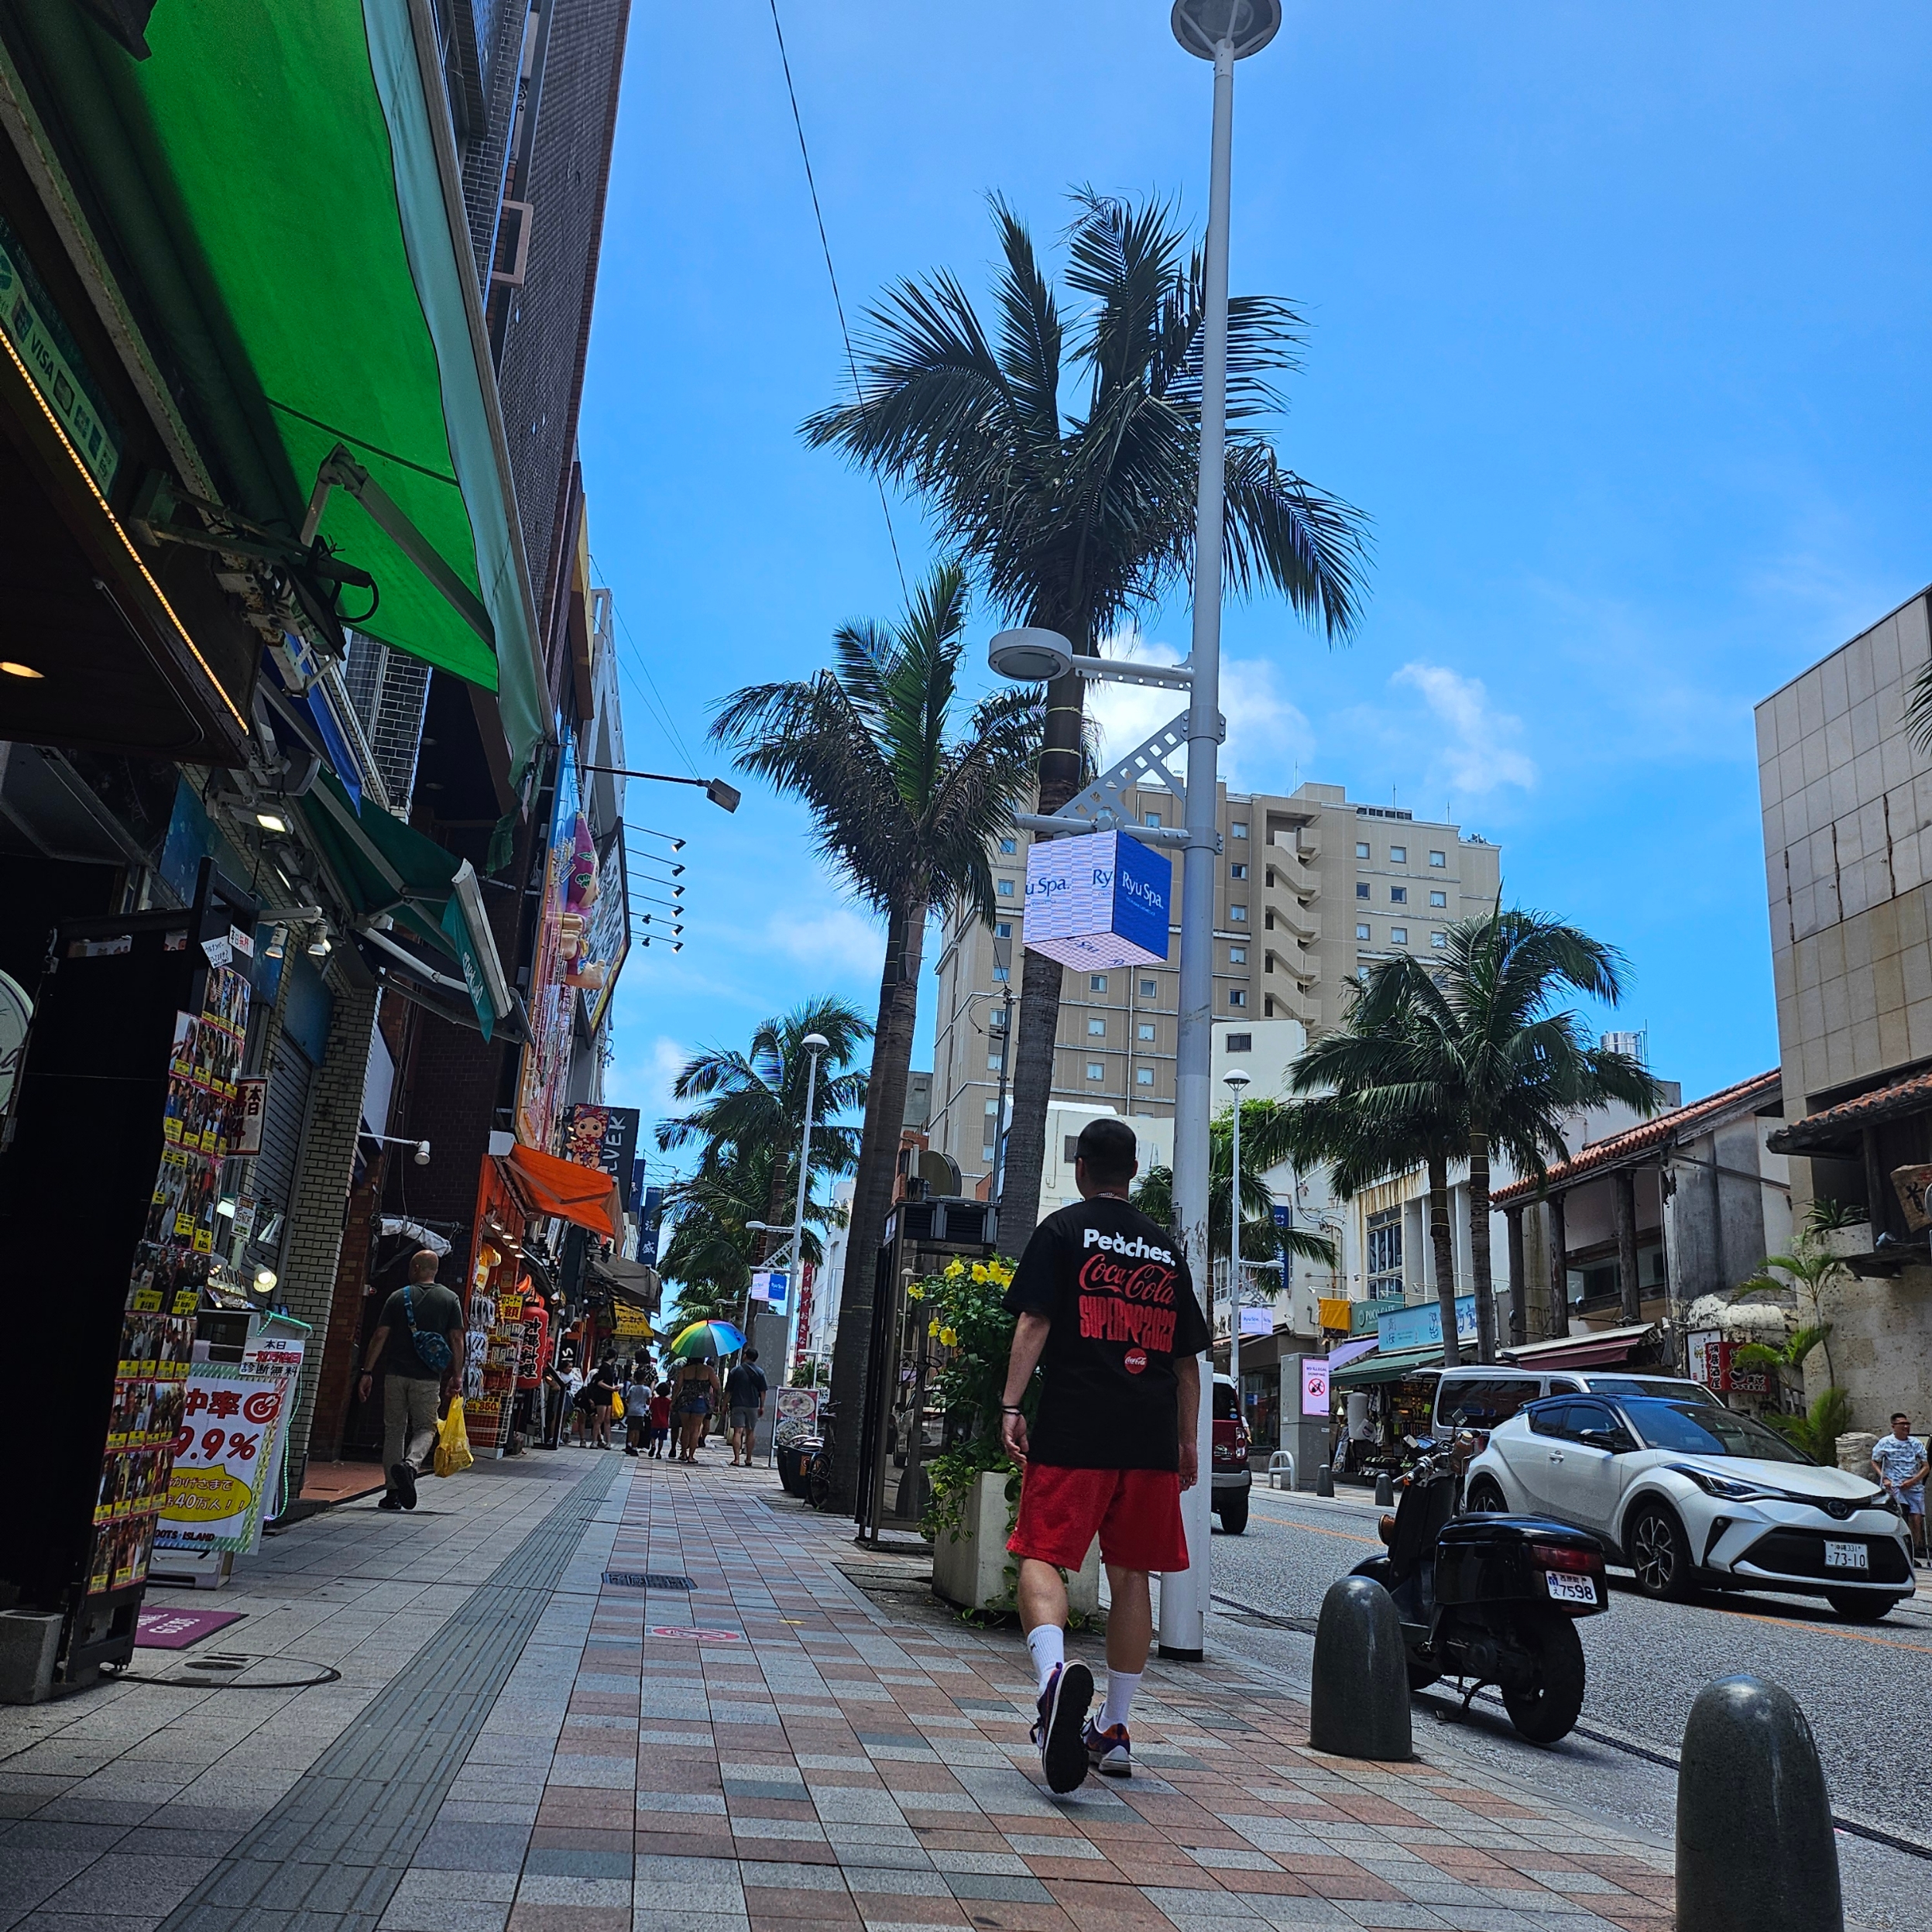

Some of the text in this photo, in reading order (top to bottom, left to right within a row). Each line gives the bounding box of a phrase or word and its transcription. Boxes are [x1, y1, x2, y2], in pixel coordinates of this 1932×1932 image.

[30, 333, 54, 375] VISA
[1038, 877, 1071, 897] Spa.
[1093, 869, 1114, 888] Ry
[1123, 870, 1164, 910] Ryu Spa.
[248, 1085, 262, 1116] 本日
[1083, 1228, 1176, 1267] Peaches.
[1079, 1253, 1179, 1305] Coca-Cola
[264, 1340, 287, 1349] 本日
[519, 1316, 541, 1378] 沖縄料理
[241, 1363, 297, 1377] 診断無料
[1834, 1552, 1865, 1567] 73-10
[1559, 1584, 1594, 1601] 7598
